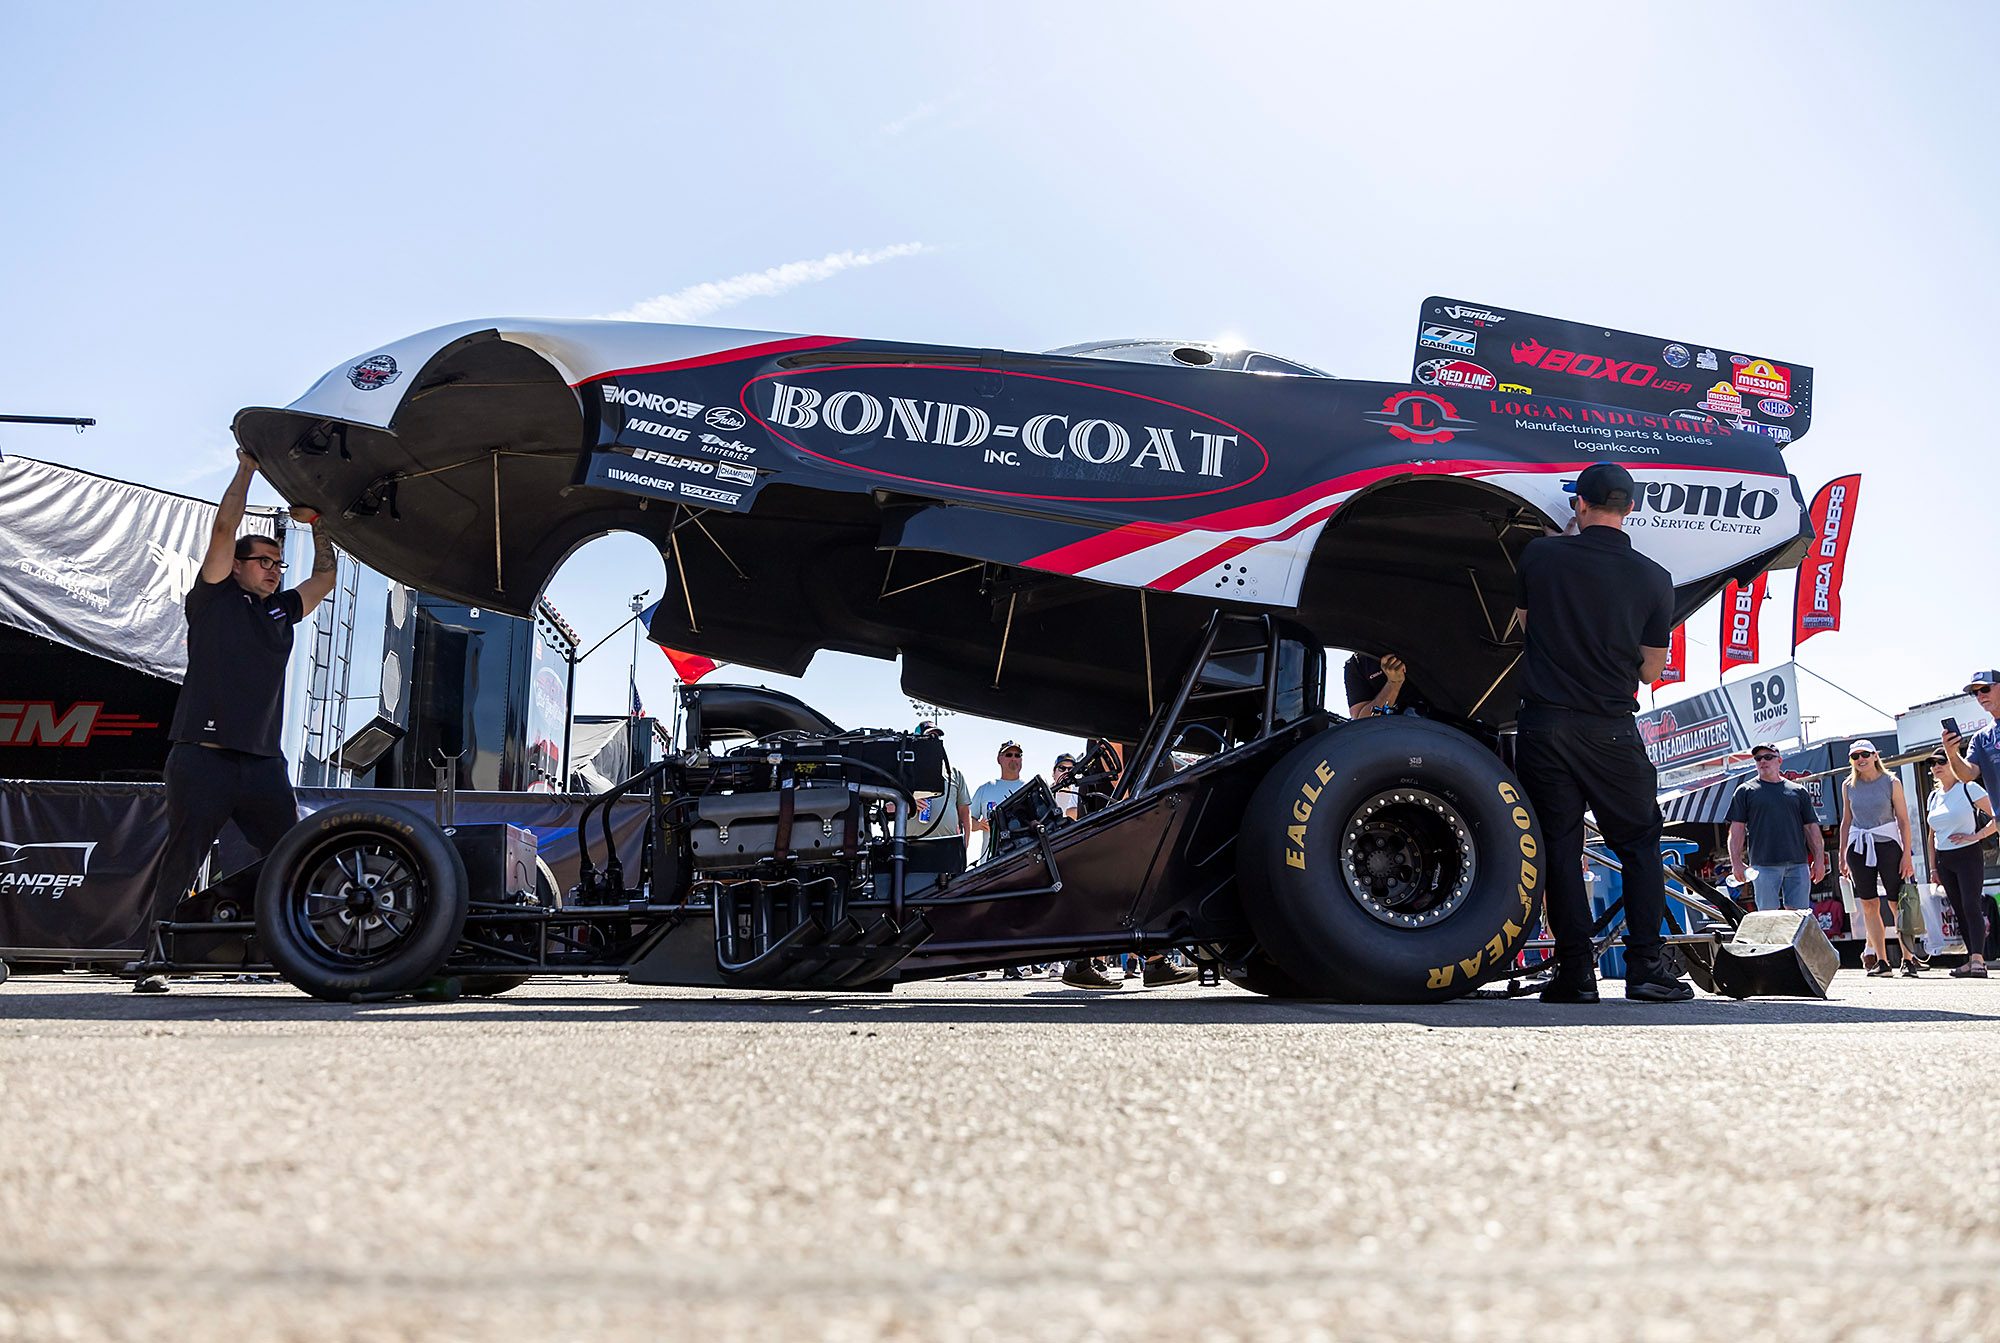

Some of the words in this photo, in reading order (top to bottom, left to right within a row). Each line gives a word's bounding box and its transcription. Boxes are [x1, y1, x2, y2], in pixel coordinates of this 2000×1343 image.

[1421, 340, 1473, 354] CARRILLO
[1439, 369, 1463, 382] RED
[1464, 372, 1492, 387] LINE
[1538, 349, 1657, 387] BOXO
[1651, 378, 1692, 394] USA
[609, 386, 690, 418] MONROE
[1764, 401, 1790, 414] NHRA
[706, 410, 742, 427] Gates
[1411, 402, 1435, 428] L
[1489, 400, 1574, 421] LOGAN
[1581, 408, 1733, 437] INDUSTRIES
[626, 418, 691, 442] MOOG
[767, 381, 1238, 478] BOND-COAT
[1515, 419, 1611, 437] Manufacturing
[1615, 429, 1649, 441] parts
[1652, 431, 1663, 441] &
[1666, 432, 1713, 446] bodies
[1768, 427, 1789, 440] STAR
[701, 445, 749, 461] BATTERIES
[983, 449, 1020, 466] INC.
[1574, 439, 1660, 455] logankc.com
[620, 469, 675, 491] WAGNER
[721, 467, 753, 480] CHAMPION
[680, 483, 741, 505] WALKER
[1621, 516, 1647, 528] UTO
[1651, 515, 1705, 530] SERVICE
[1710, 518, 1761, 535] CENTER
[1821, 485, 1846, 557] ENDERS
[20, 562, 56, 584] BLAKE
[55, 577, 110, 607] ALEXANDER
[1814, 562, 1833, 611] ERICA
[1732, 613, 1750, 645] BO
[1750, 675, 1785, 711] BO
[1753, 704, 1788, 723] KNOWS
[1659, 722, 1729, 763] HEADQUARTERS
[1286, 760, 1336, 870] EAGLE
[0, 873, 84, 887] ANDER
